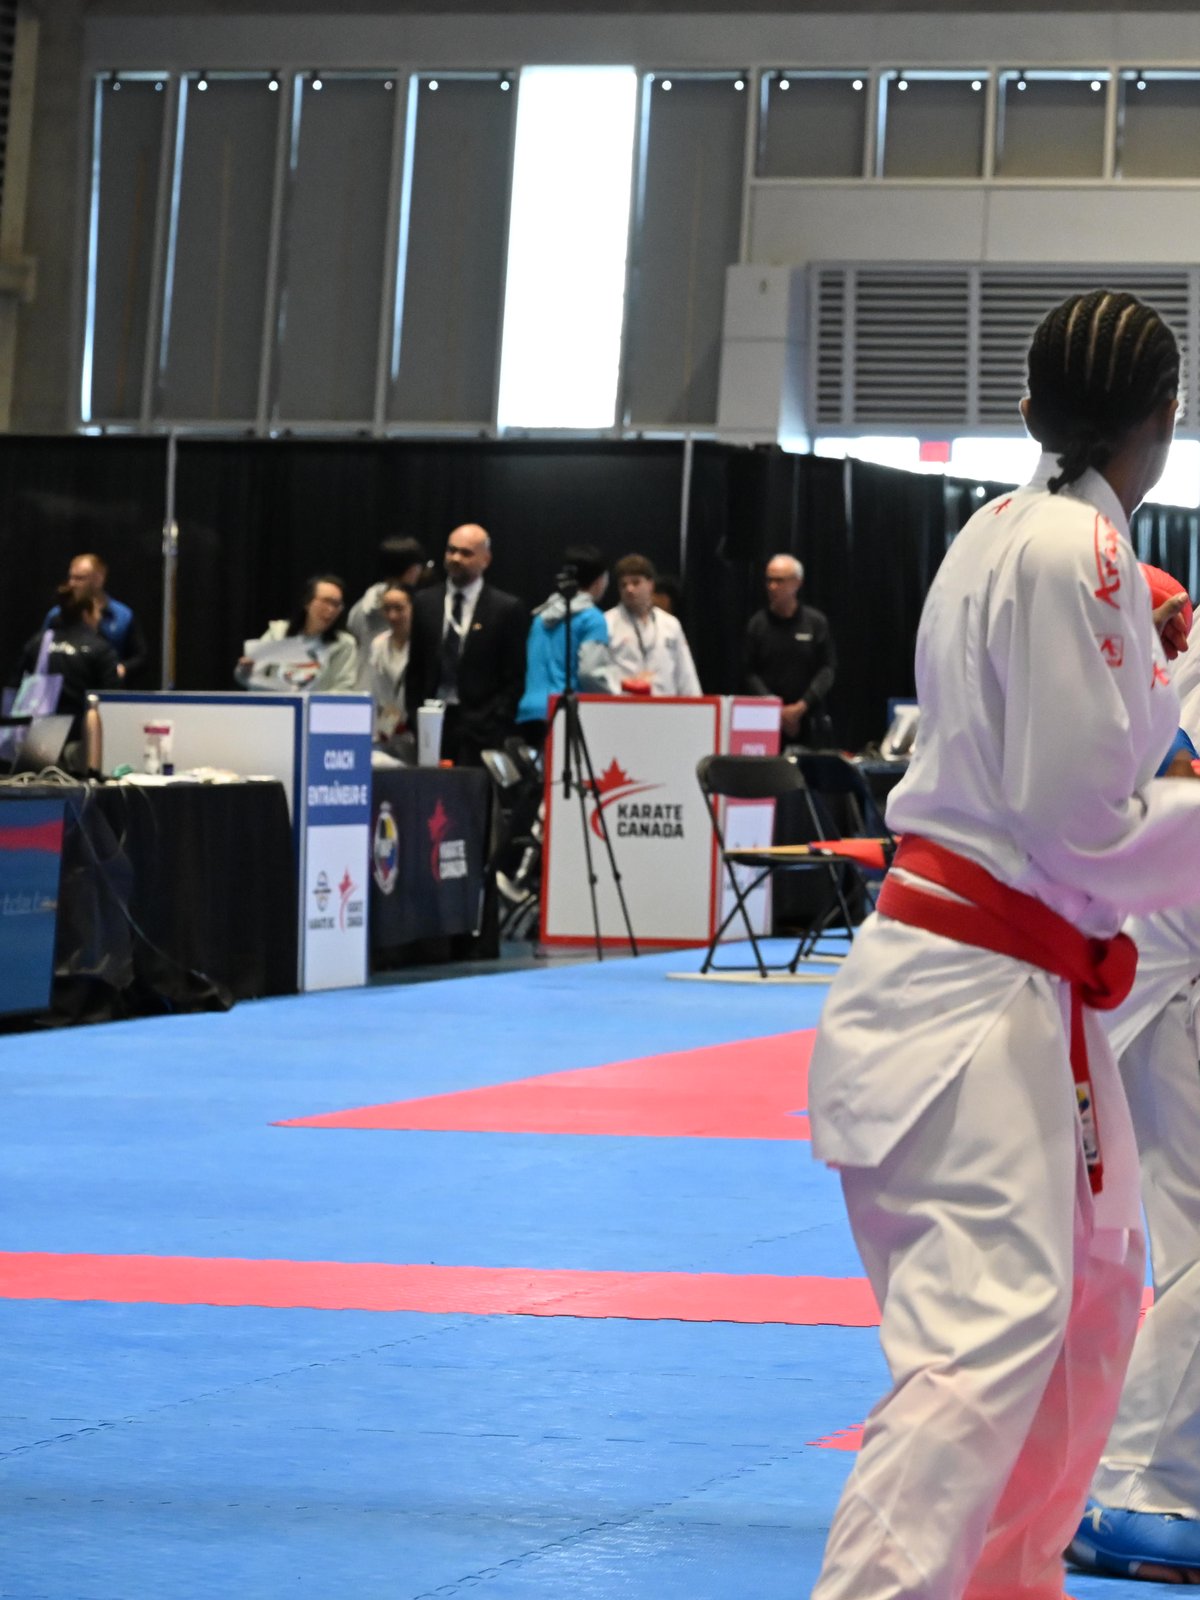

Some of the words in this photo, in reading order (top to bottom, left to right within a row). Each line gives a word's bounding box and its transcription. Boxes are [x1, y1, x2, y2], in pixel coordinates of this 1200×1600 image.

[324, 749, 355, 770] COACH
[617, 803, 683, 821] KARATE
[617, 821, 684, 838] CANADA
